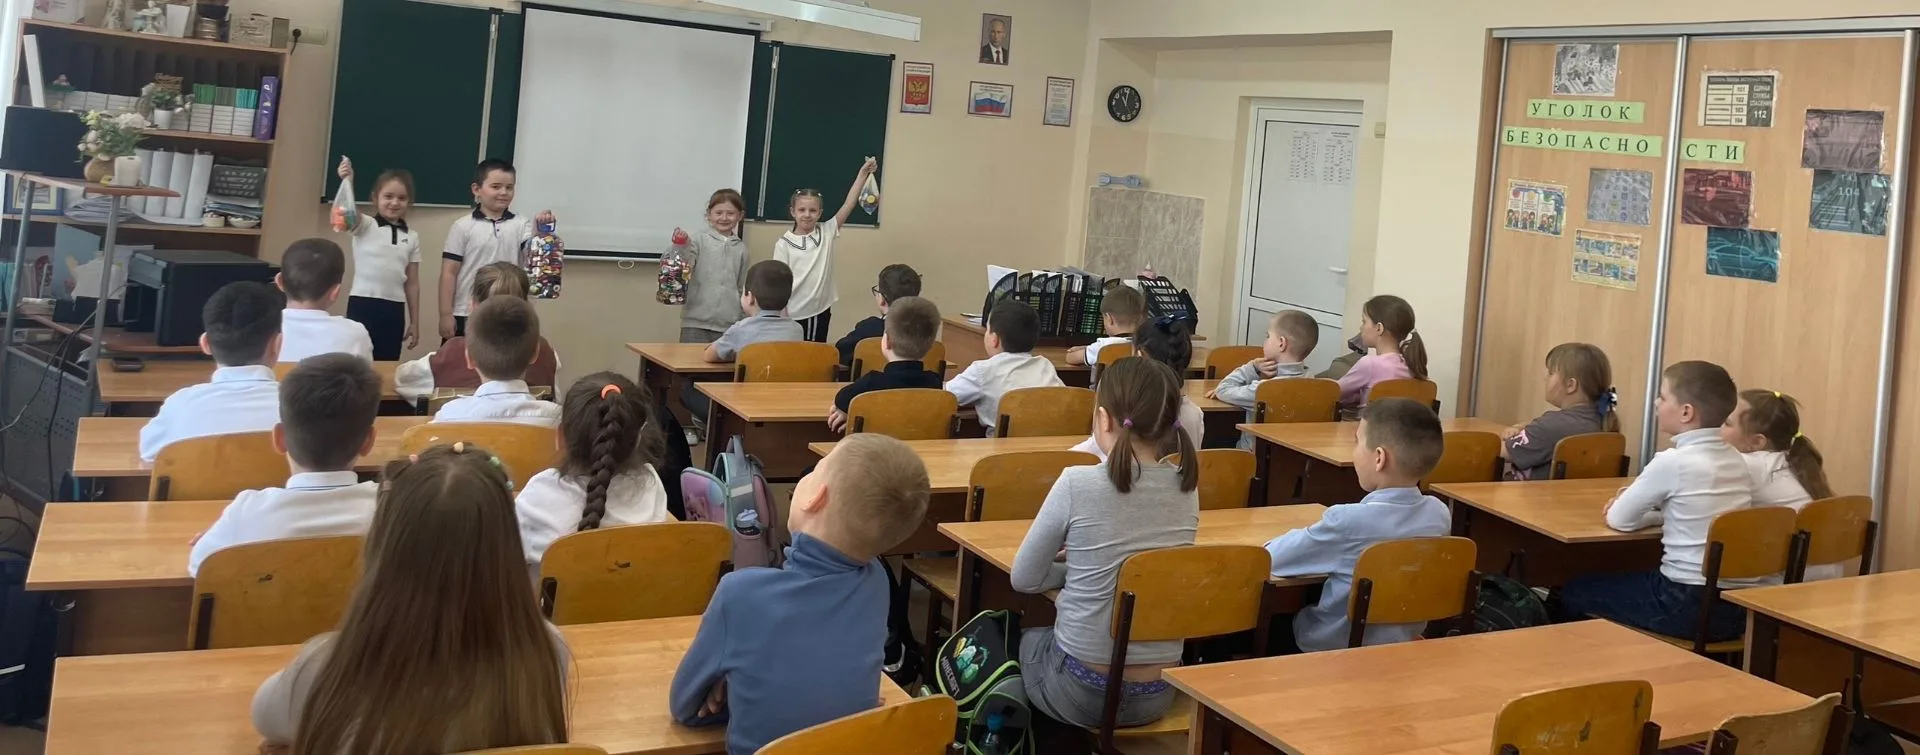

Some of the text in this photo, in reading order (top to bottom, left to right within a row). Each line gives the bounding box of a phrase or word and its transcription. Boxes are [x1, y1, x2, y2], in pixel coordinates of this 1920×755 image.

[1531, 102, 1632, 120] УГОЛОК
[1754, 110, 1767, 119] 112
[1506, 129, 1740, 161] БЕЗОПАСНО СТИ
